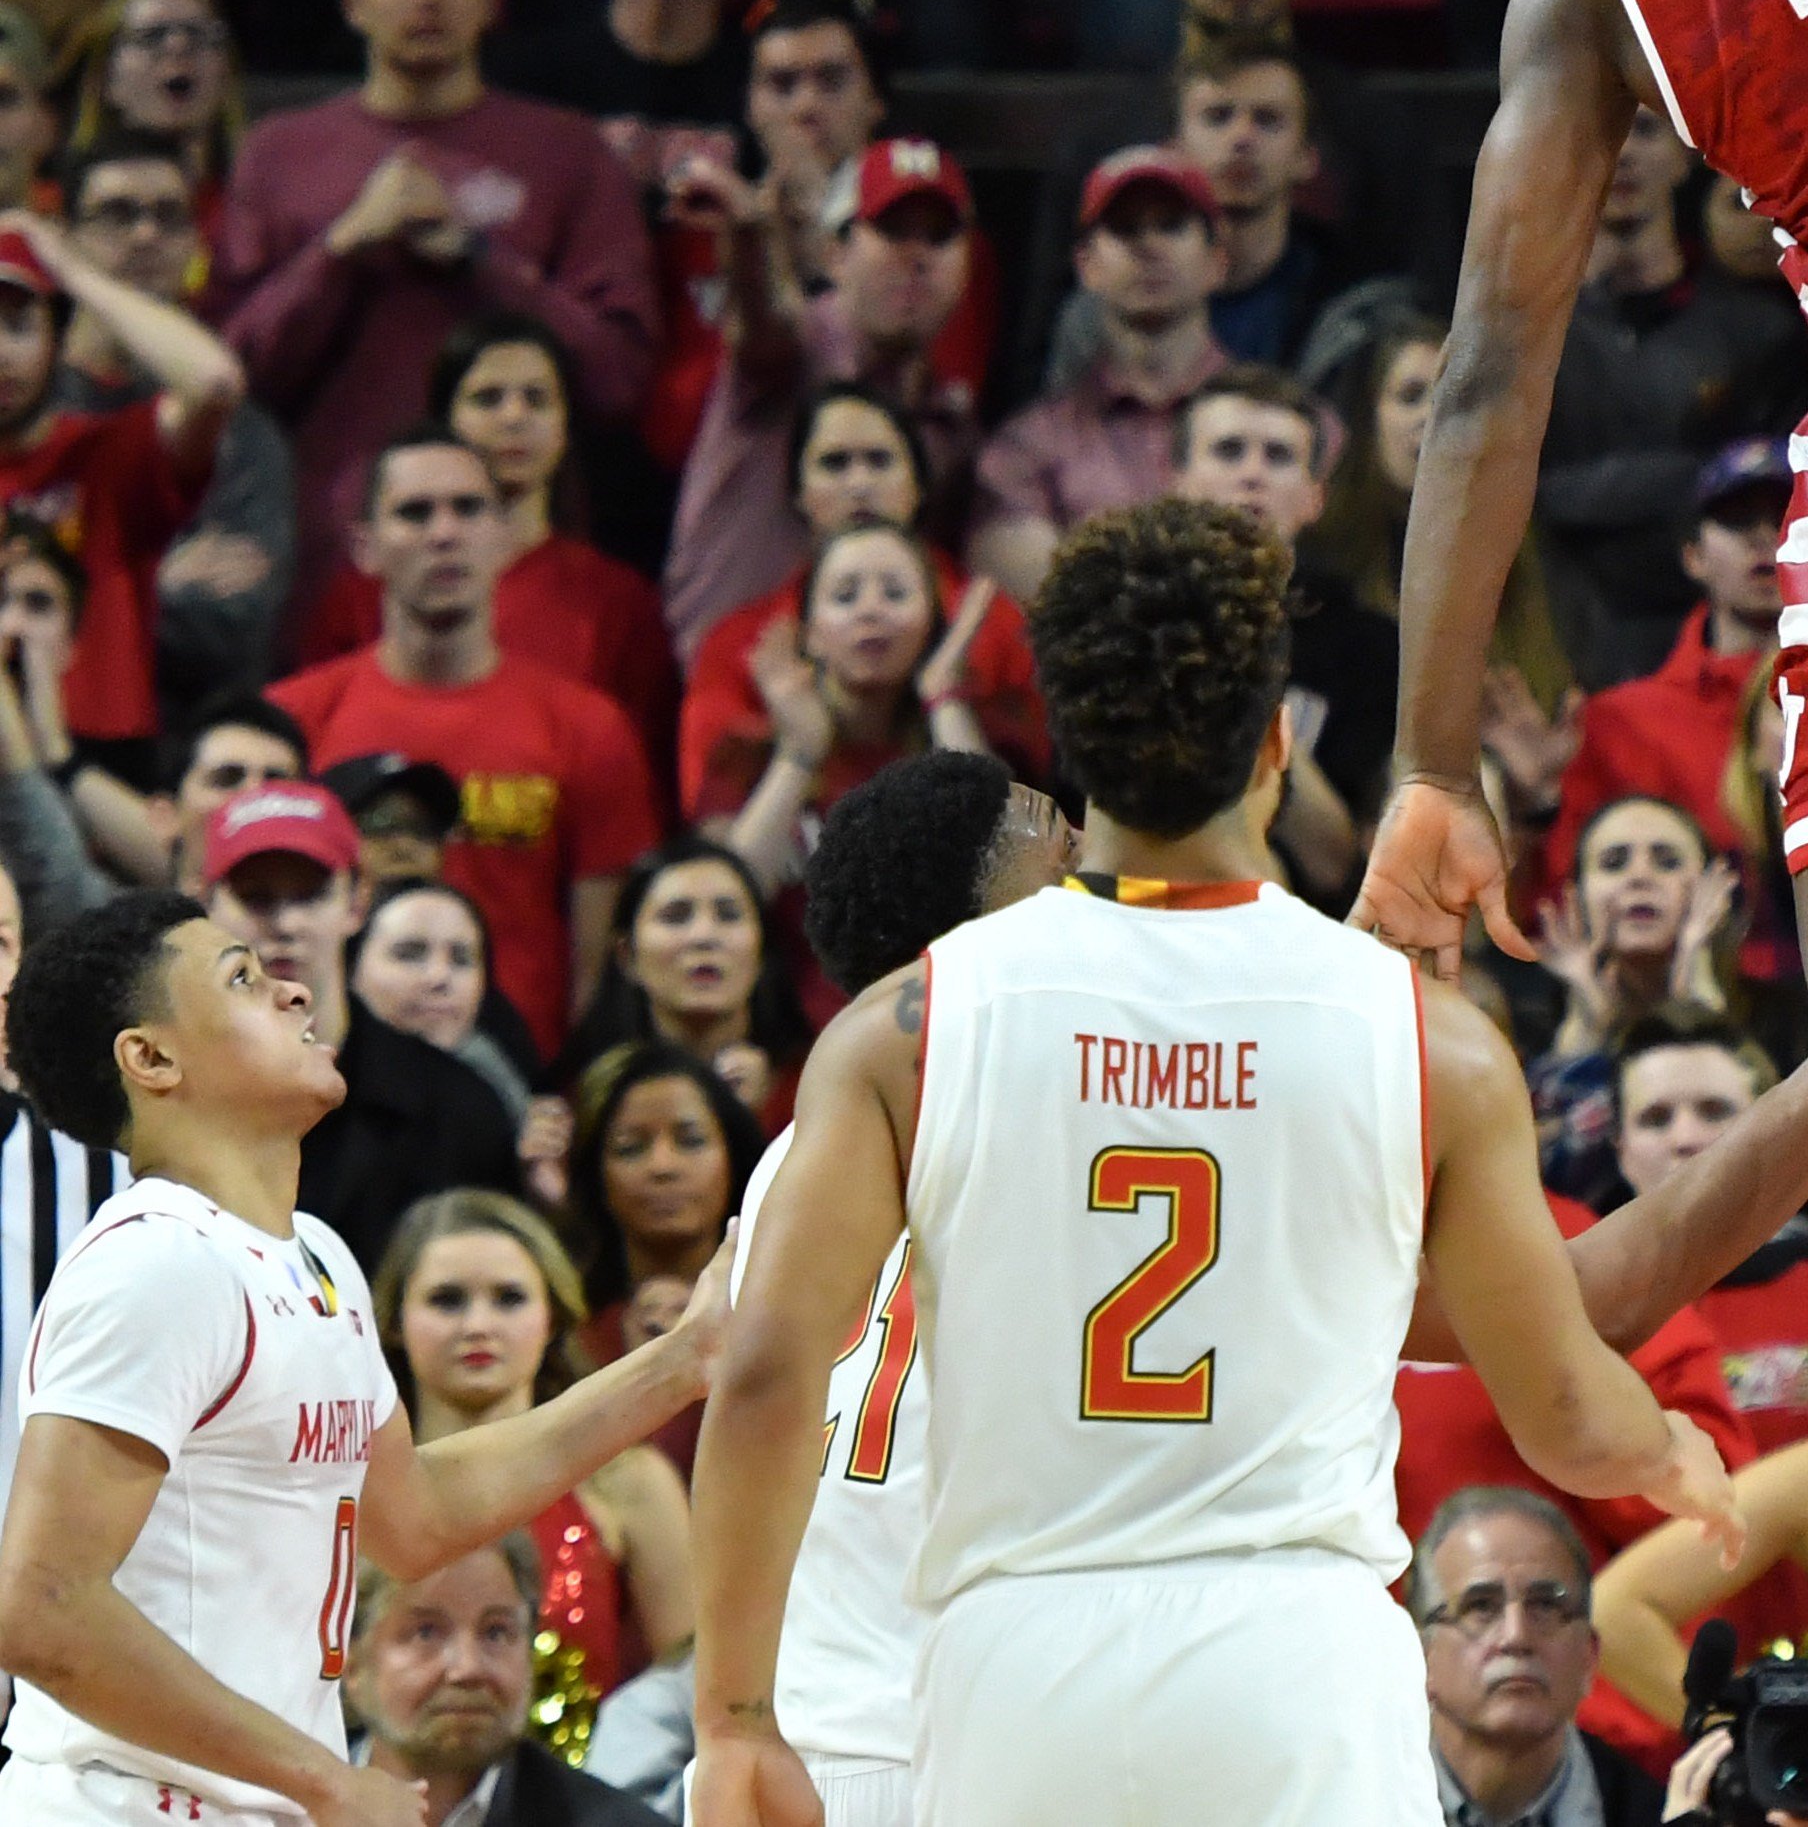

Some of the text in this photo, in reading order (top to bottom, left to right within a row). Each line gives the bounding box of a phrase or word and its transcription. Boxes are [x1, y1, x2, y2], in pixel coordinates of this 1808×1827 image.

[1074, 1032, 1258, 1110] TRIMBLE
[1079, 1144, 1222, 1424] 2
[318, 1496, 357, 1680] 0
